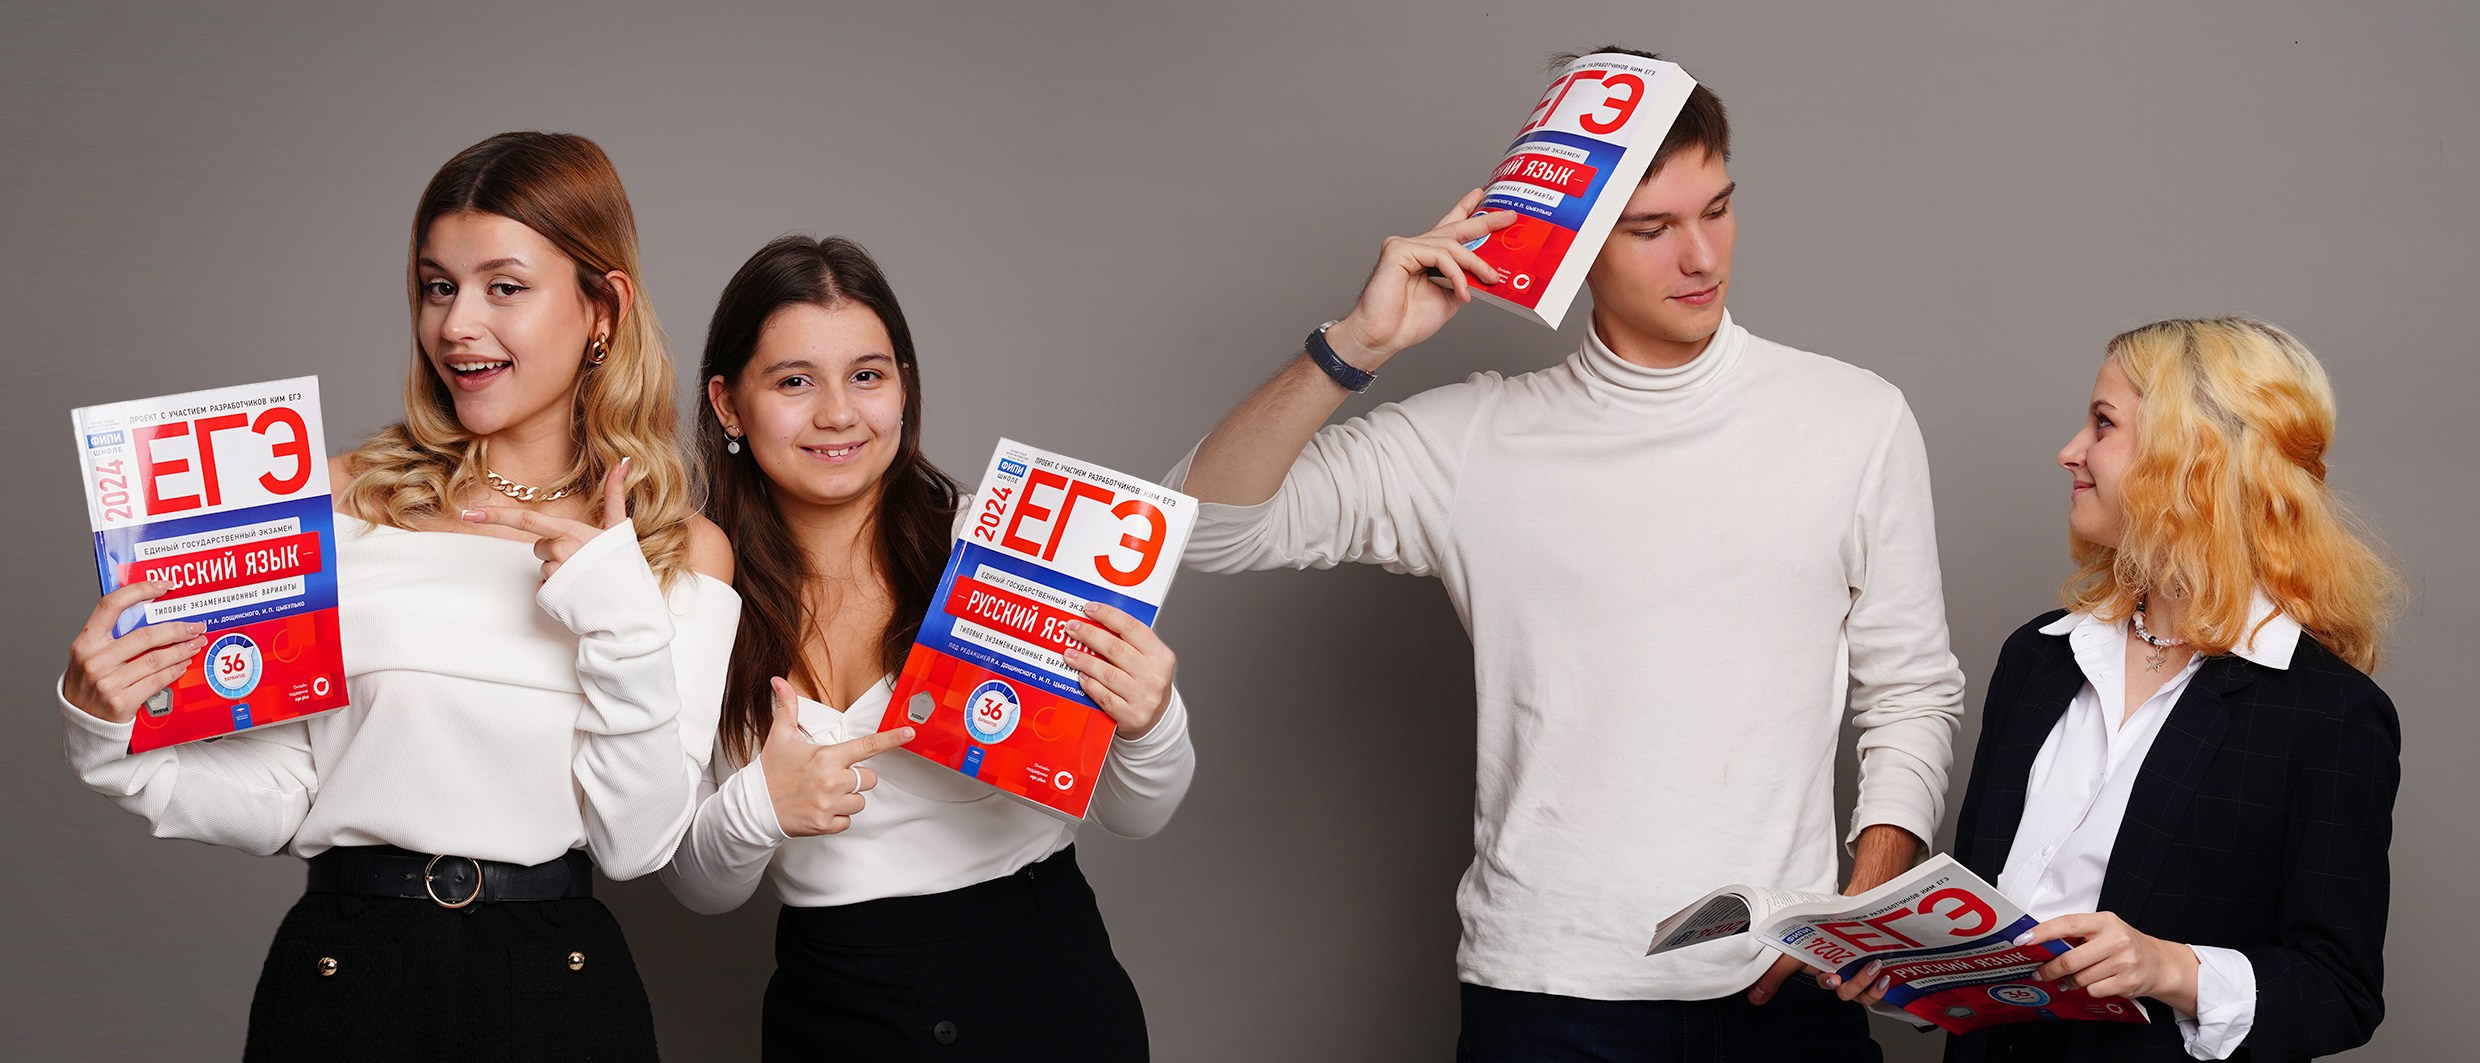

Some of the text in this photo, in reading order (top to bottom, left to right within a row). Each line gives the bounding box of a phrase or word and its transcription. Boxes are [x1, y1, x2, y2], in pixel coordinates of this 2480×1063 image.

[1644, 68, 1656, 77] ЕГЭ
[1516, 69, 1645, 139] ЕГЭ
[1551, 147, 1581, 160] ЭКЗАМЕН
[1522, 159, 1575, 187] ЯЗЫК
[1522, 187, 1555, 201] ВАРИАНТЫ
[129, 392, 302, 425] ПРОЕКТ С УЧАСТИЕМ РАЗРАБОТЧИКОВ КИМ ЕГЭ
[90, 432, 122, 446] ФИПИ
[93, 446, 123, 457] ШКОЛЕ
[131, 406, 312, 516] ЕГЭ
[1001, 461, 1025, 476] ФИПИ
[96, 459, 134, 523] 2024
[997, 473, 1019, 485] ШКОЛЕ
[1034, 457, 1177, 507] ПРОЕКТ С УЧАСТИЕМ РАЗРАБОТЧИКОВ КИМ ЕГЭ
[974, 486, 1013, 543] 2024
[1000, 467, 1167, 588] ЕГЭ
[144, 524, 293, 556] ЕДИНЫЙ ГОСУДАРСТВЕННЫЙ ЭКЗАМЕН
[145, 543, 300, 589] РУССКИЙ ЯЗЫК
[154, 583, 297, 616] ТИПОВЫЕ ЭКЗАМЕНАЦИОННЫЕ ВАРИАНТЫ
[980, 571, 1067, 606] ЕДИНЫЙ ГОСУДАРСТВЕННЫЙ
[220, 609, 261, 624] ДОЩИНСКОГО,
[275, 600, 305, 613] ЦЫБУЛЬКО
[966, 589, 1039, 634] РУССКИЙ
[947, 642, 959, 651] ПОД
[959, 646, 991, 662] РЕДАКЦИЕЙ
[959, 625, 984, 640] ТИПОВЫЕ
[985, 634, 1043, 662] ЭКЗАМЕНАЦИОННЫЕ
[220, 652, 246, 675] 36
[980, 697, 1004, 720] 36
[1920, 884, 1937, 895] КИМ
[1936, 876, 1950, 886] ЕГЭ
[1786, 926, 1811, 942] ФИПИ
[1814, 887, 1998, 953] ЕГЭ
[1804, 936, 1857, 965] 2024
[1892, 951, 2032, 979] РУССКИЙ ЯЗЫК
[2003, 989, 2031, 999] 36
